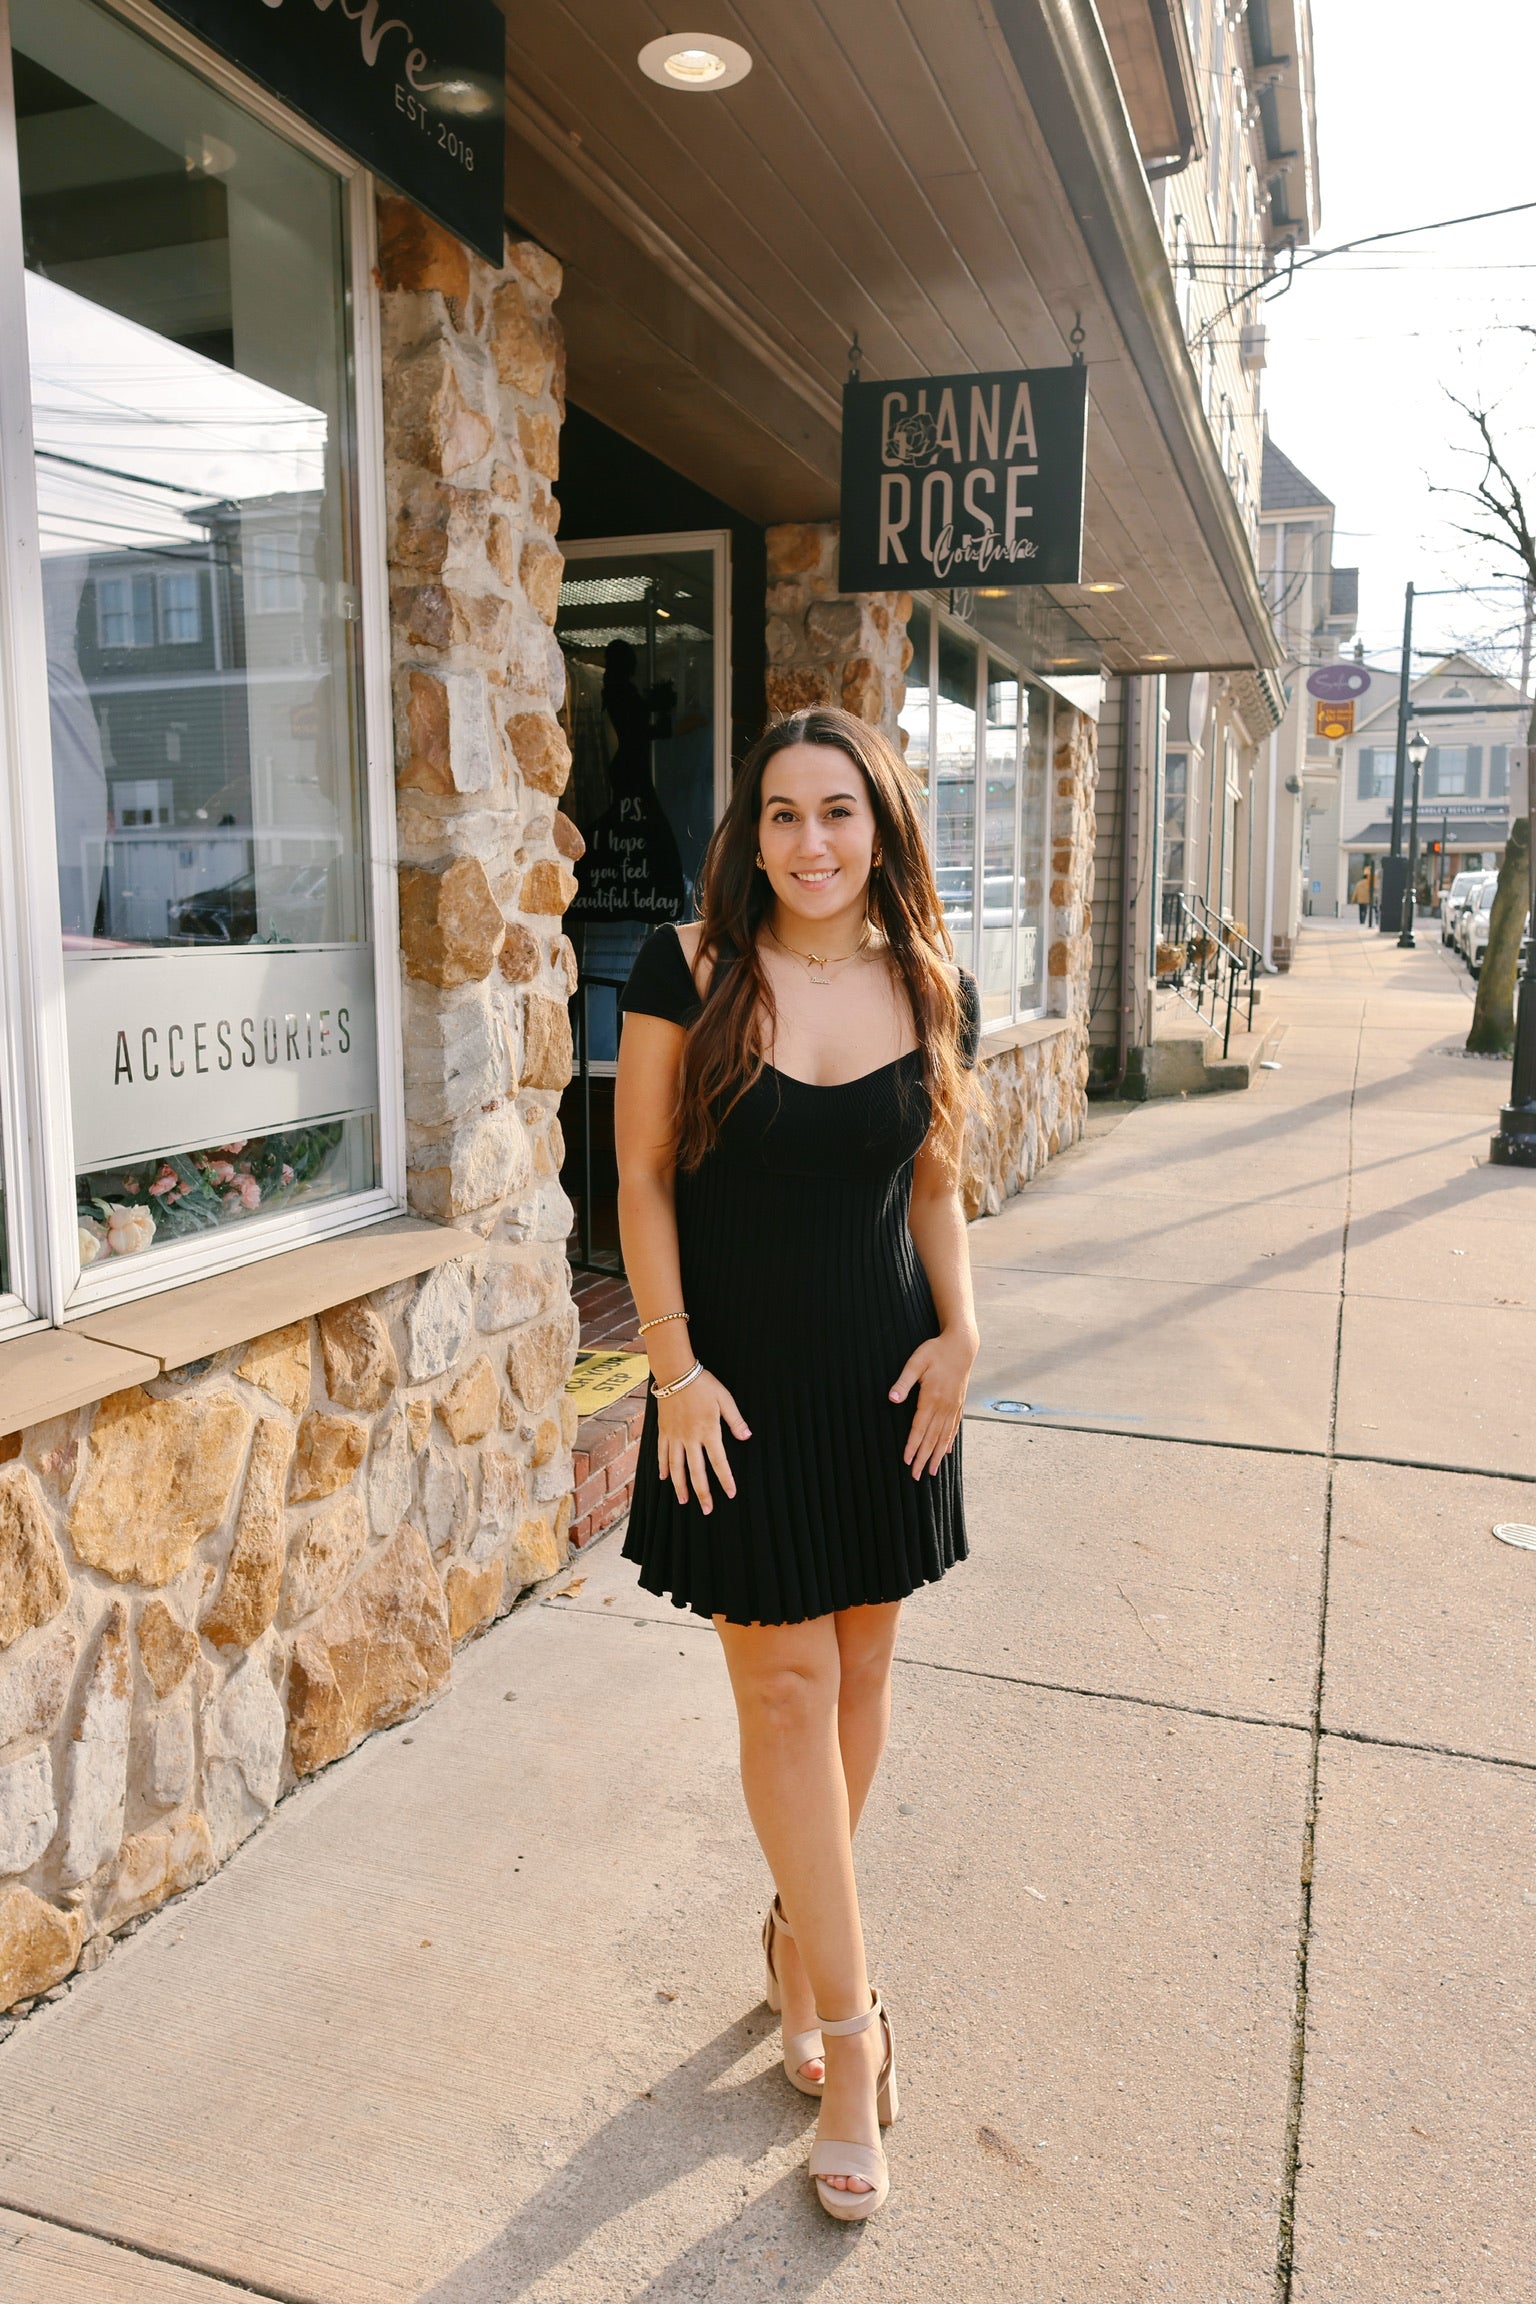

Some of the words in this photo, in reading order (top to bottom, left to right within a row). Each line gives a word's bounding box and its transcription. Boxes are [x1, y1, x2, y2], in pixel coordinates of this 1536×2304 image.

[394, 83, 432, 136] EST.
[437, 122, 475, 172] 2018
[878, 464, 1039, 565] ROSE
[932, 524, 1039, 578] Couture
[593, 830, 599, 850] I
[608, 829, 647, 857] hope
[590, 866, 618, 888] you
[620, 857, 650, 883] feel
[632, 887, 679, 917] today
[114, 1007, 351, 1086] ACCESSORIES
[581, 1356, 631, 1376] YOUR
[591, 1372, 633, 1392] STEP
